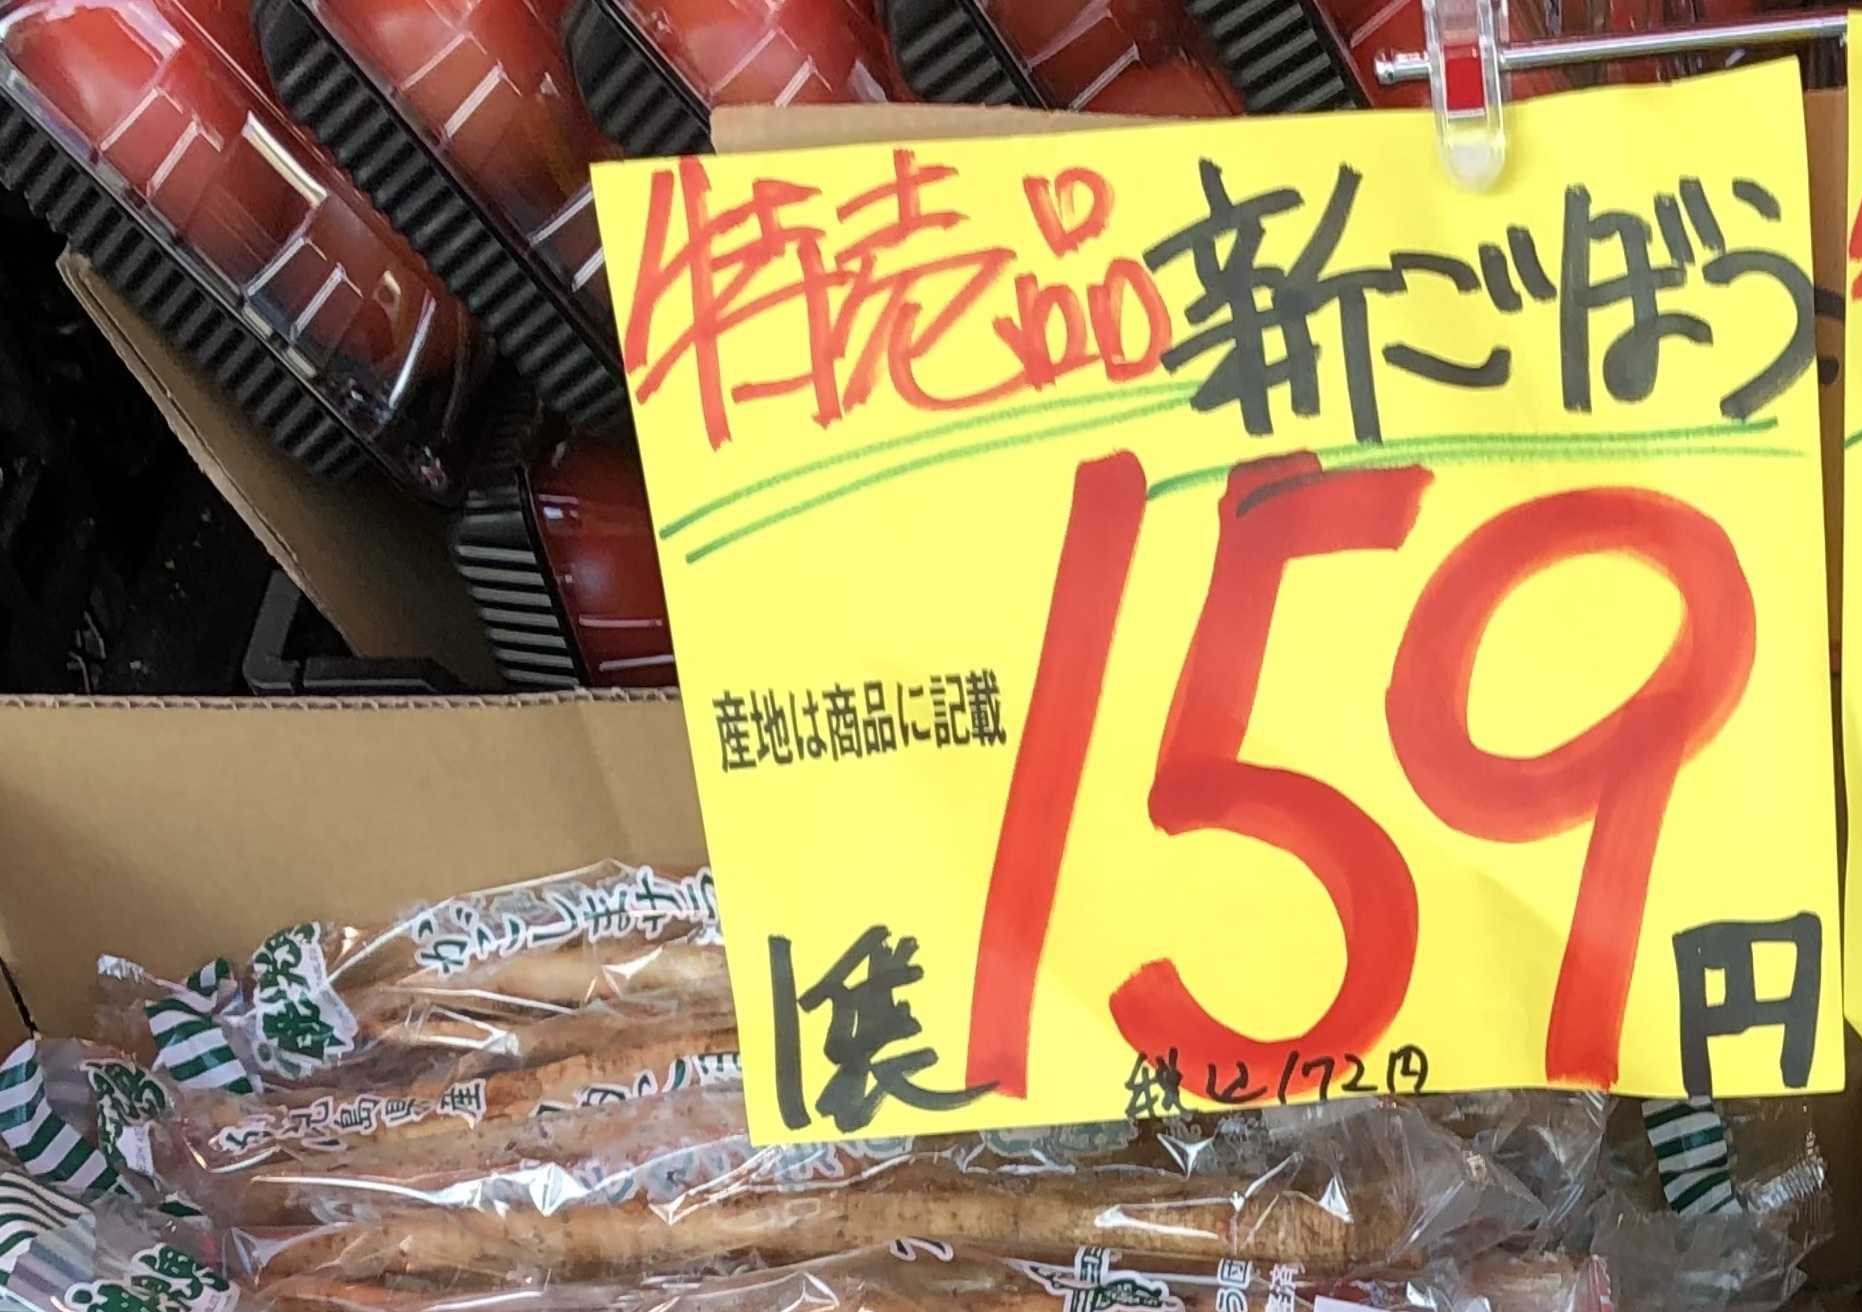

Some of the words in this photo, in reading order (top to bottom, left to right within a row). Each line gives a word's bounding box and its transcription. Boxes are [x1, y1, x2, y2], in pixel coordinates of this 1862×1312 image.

[622, 150, 1170, 448] 特売品
[1144, 158, 1845, 443] 新ごぼう
[714, 669, 1008, 774] 産地は商品に記載
[966, 450, 1758, 1100] 159
